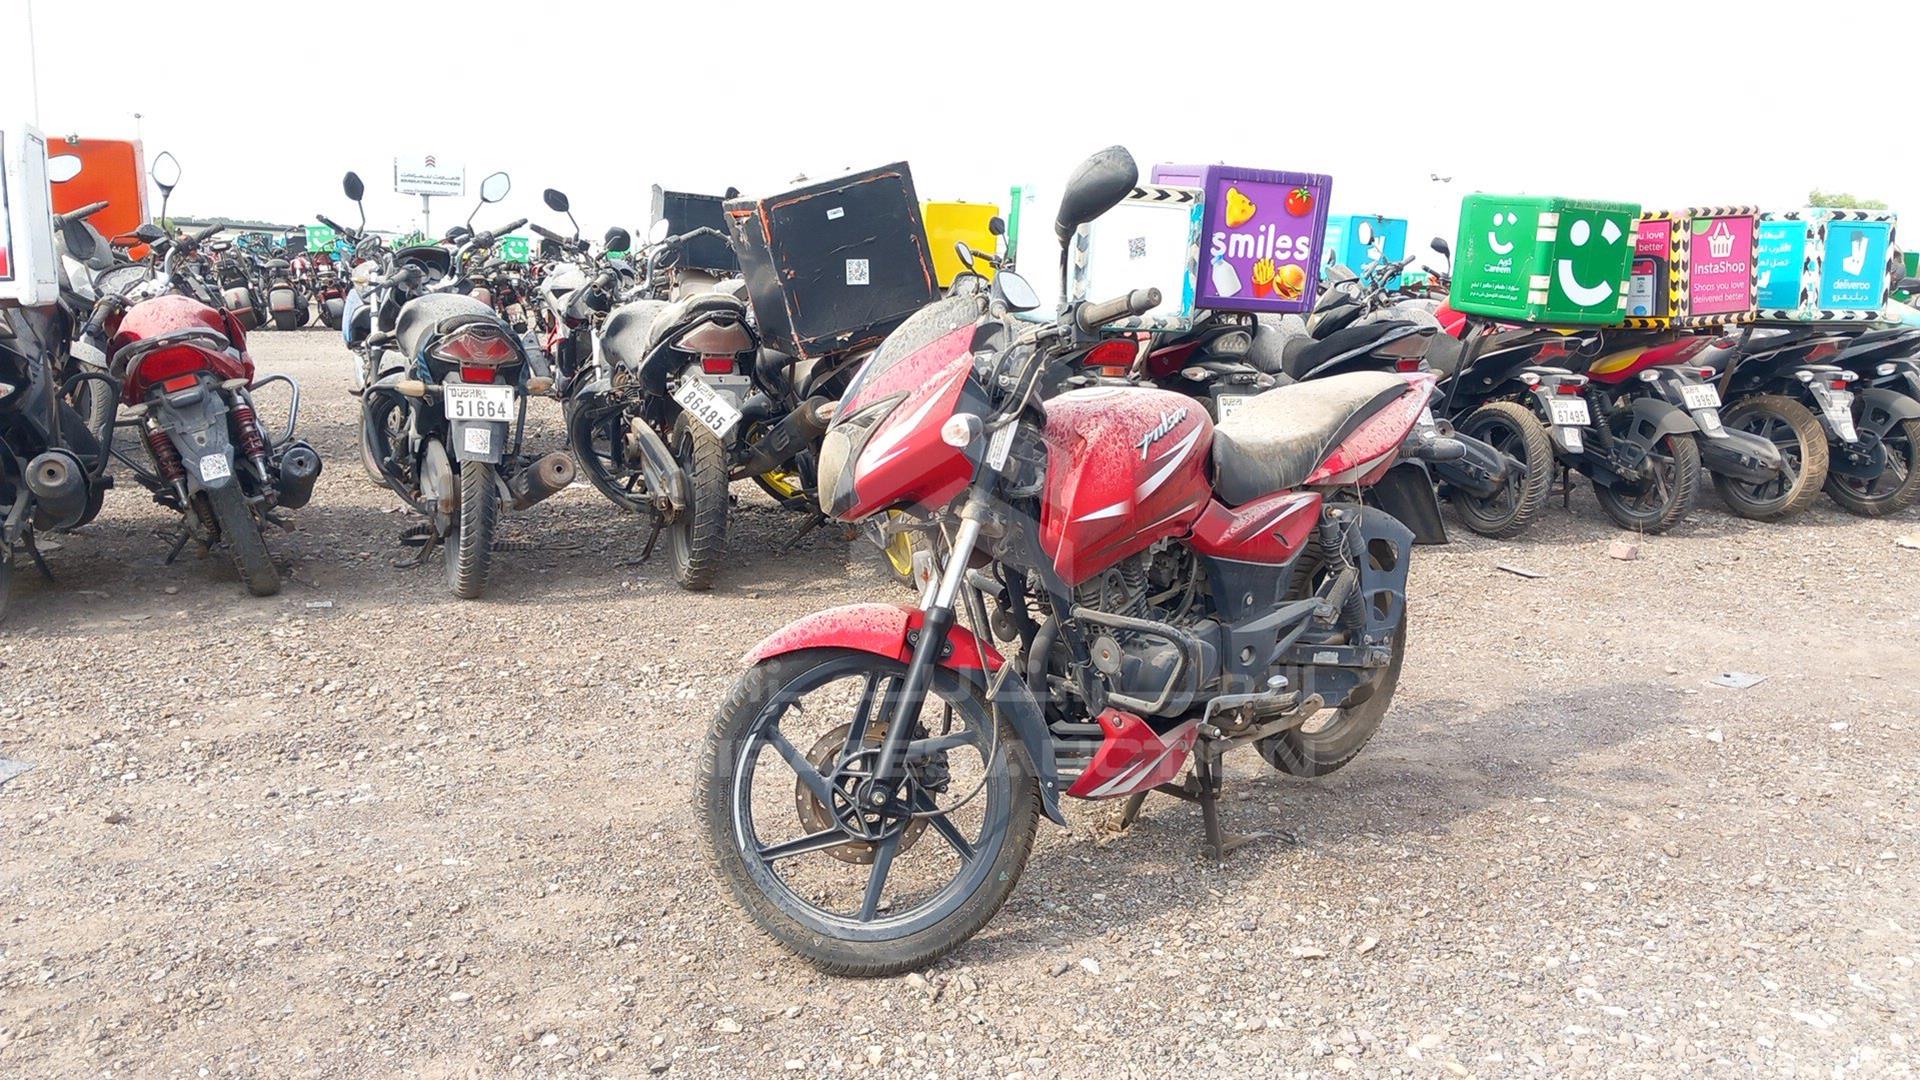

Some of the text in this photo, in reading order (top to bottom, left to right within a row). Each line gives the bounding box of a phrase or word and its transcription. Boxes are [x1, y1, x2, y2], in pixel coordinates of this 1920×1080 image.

[1646, 230, 1664, 240] love
[1210, 223, 1311, 261] smiles
[1639, 242, 1664, 252] better
[1694, 261, 1746, 275] InstaShop
[1693, 280, 1745, 292] Shops you love
[1833, 278, 1871, 290] deliveroo
[1693, 292, 1744, 304] delivered better
[456, 400, 506, 418] 51664
[683, 391, 726, 431] 86485
